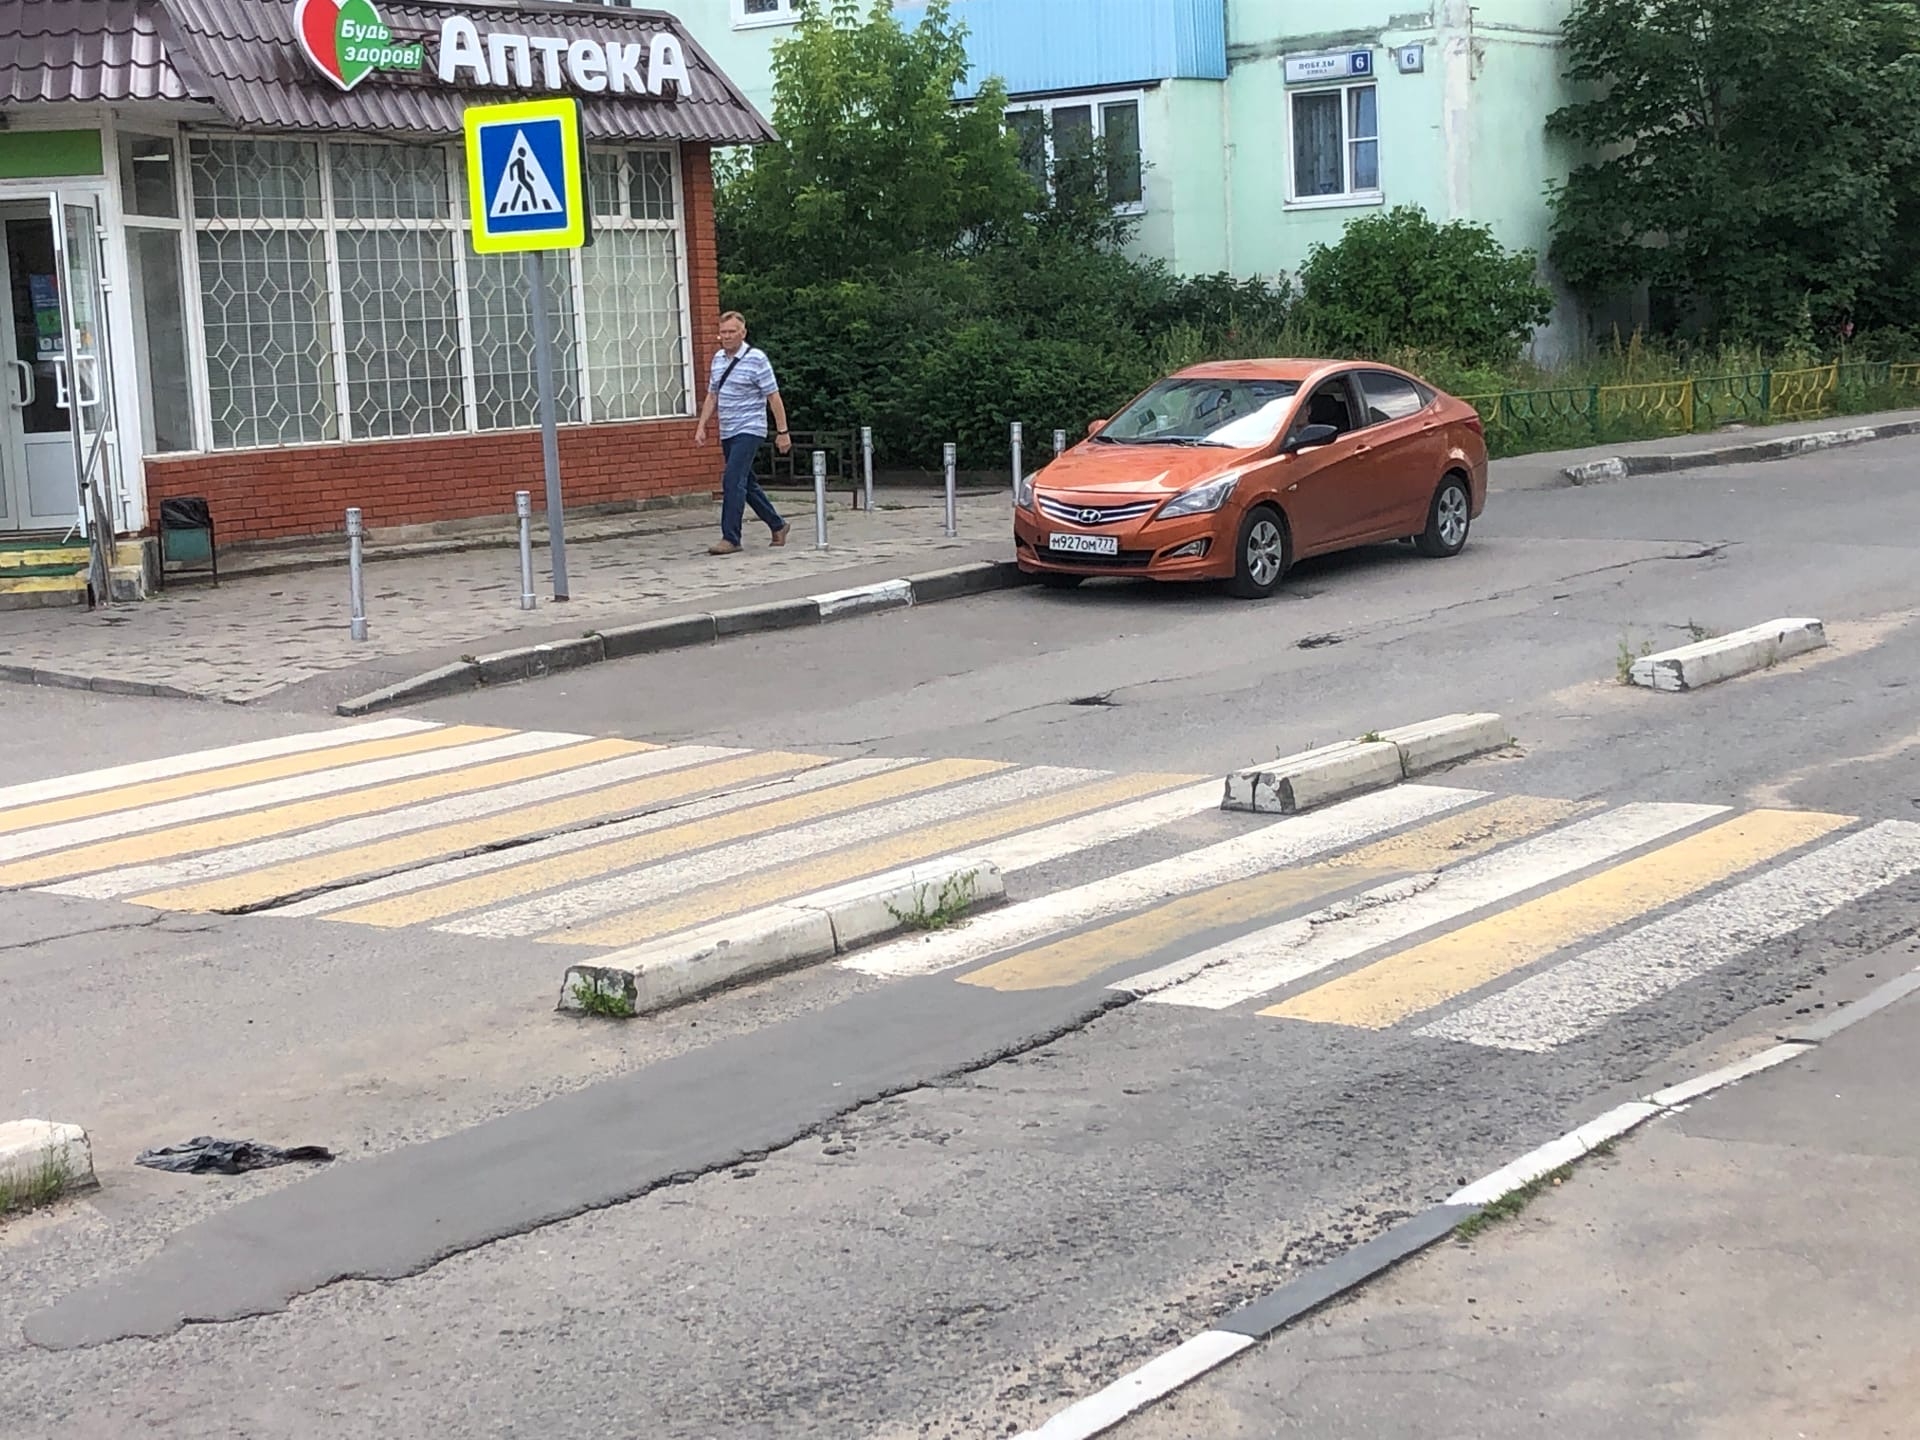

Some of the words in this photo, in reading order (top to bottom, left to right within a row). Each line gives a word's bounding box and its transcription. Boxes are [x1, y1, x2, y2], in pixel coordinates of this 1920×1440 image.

[340, 19, 389, 41] Будь
[344, 45, 420, 66] здоров!
[1298, 59, 1335, 70] ПОБЕДЫ
[1355, 56, 1364, 69] 6
[1407, 53, 1415, 65] 6
